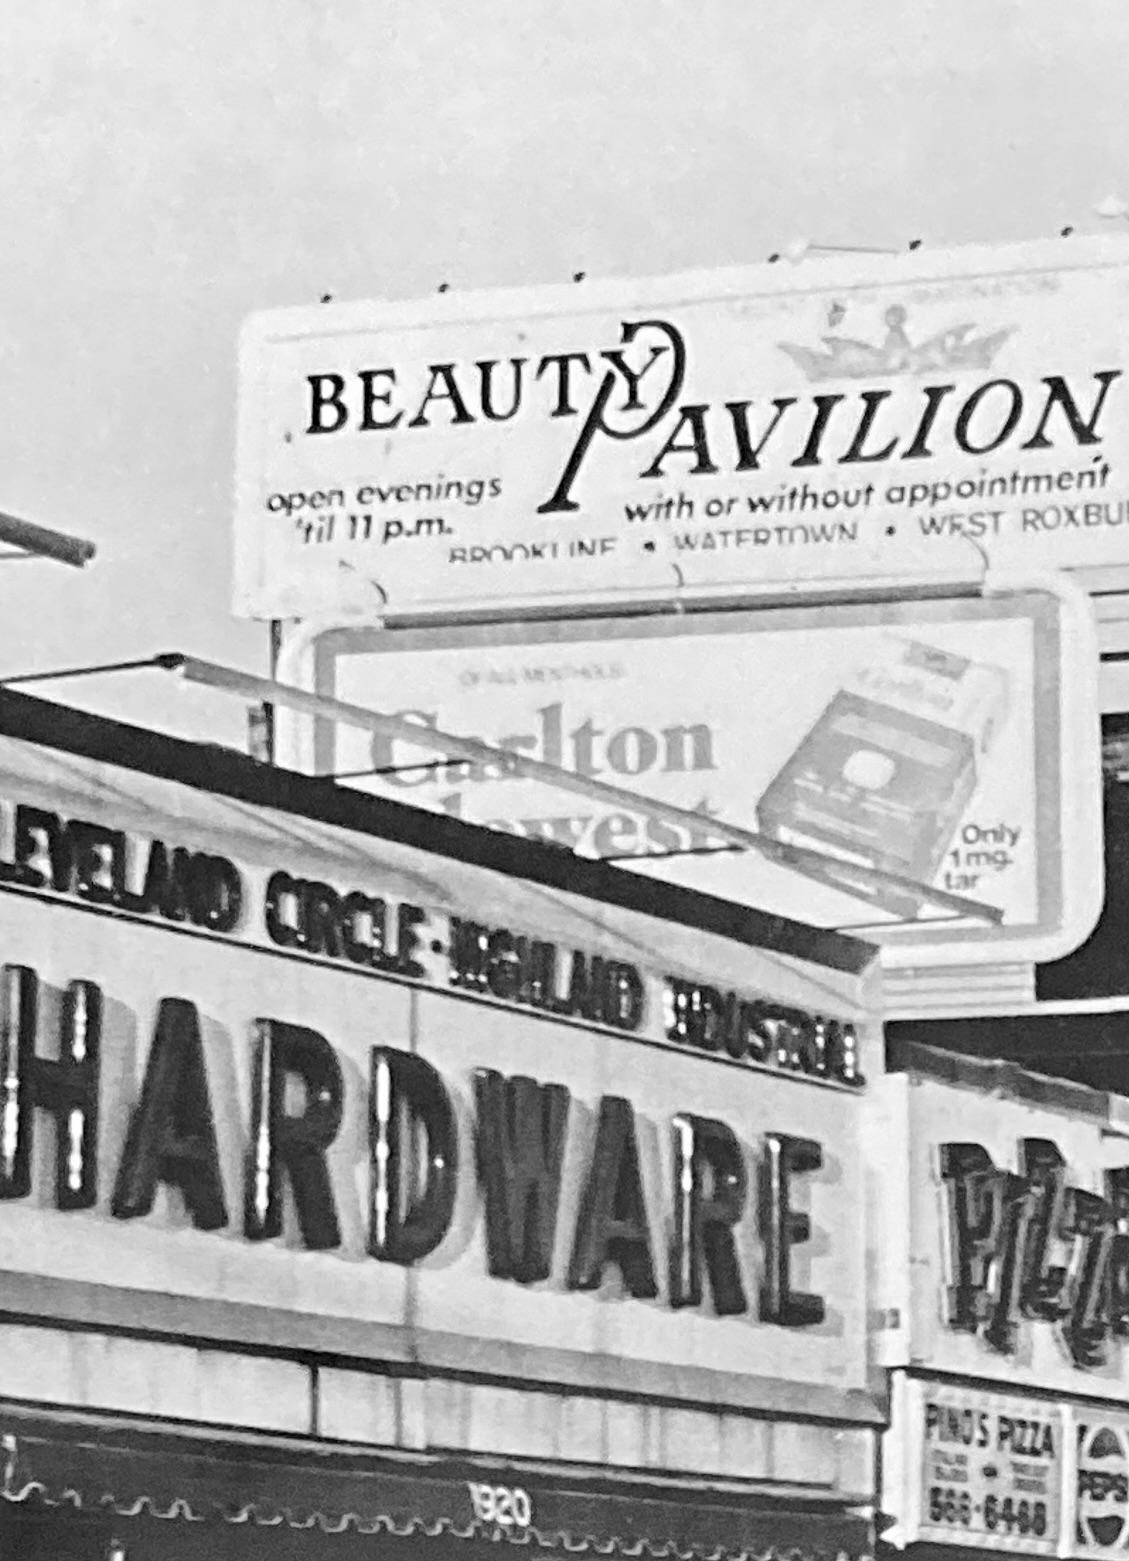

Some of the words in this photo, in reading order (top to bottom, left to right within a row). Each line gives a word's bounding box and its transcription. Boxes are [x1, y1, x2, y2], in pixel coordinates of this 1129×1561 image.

[305, 344, 669, 435] BEAUTY
[537, 319, 1122, 513] PAVILION
[266, 488, 347, 517] open
[356, 474, 502, 509] evenings
[624, 490, 696, 524] with
[704, 495, 738, 518] or
[746, 483, 875, 515] without
[884, 461, 1112, 510] appointment
[296, 515, 337, 545] 'til
[349, 514, 373, 539] 11
[383, 514, 455, 545] p.m.
[674, 521, 860, 552] WATERTOWN
[918, 510, 1006, 539] WEST
[961, 823, 1021, 847] Only
[0, 804, 243, 932] EVELAND
[944, 872, 980, 891] tar
[1, 963, 828, 1328] HARDWARE
[997, 1414, 1056, 1459] PIZZA
